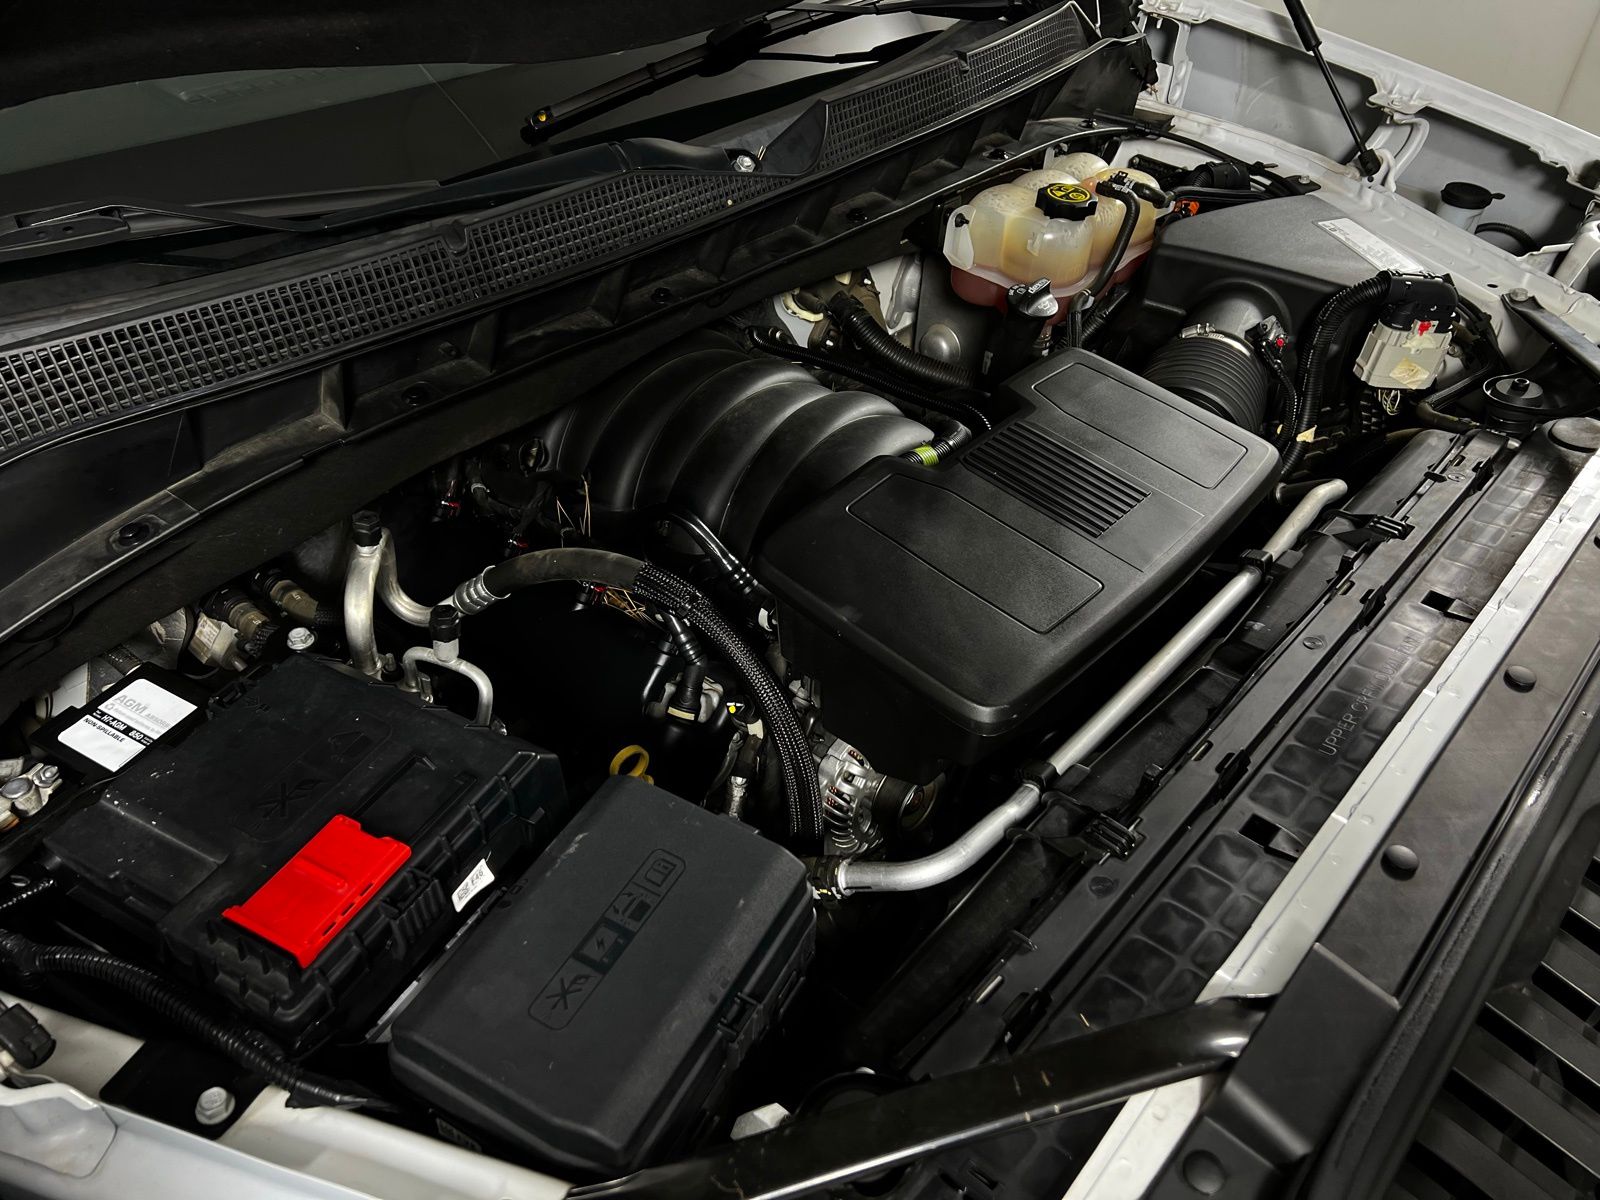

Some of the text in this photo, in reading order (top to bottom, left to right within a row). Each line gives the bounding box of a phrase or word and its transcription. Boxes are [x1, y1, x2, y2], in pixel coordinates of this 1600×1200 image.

[114, 694, 147, 714] AGM
[83, 718, 125, 743] NON-SPILLABLE
[1318, 712, 1359, 756] UPPER
